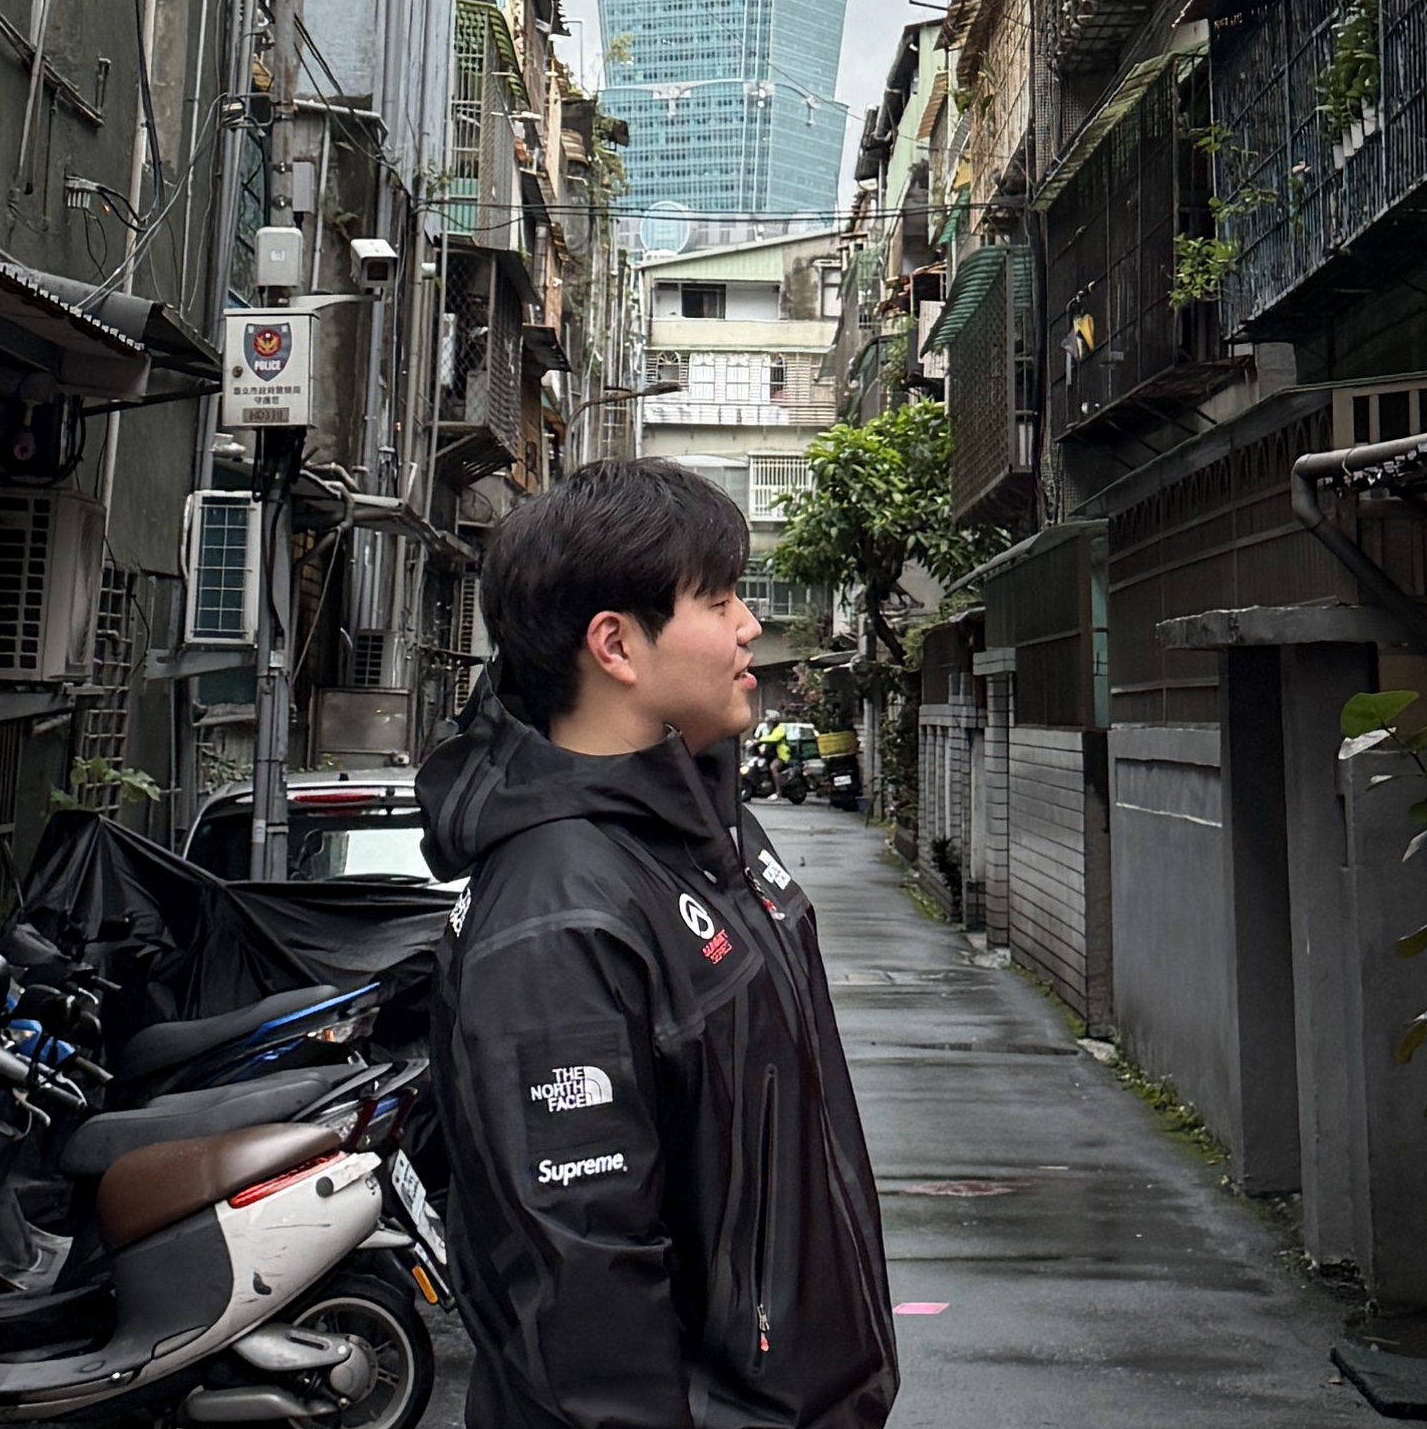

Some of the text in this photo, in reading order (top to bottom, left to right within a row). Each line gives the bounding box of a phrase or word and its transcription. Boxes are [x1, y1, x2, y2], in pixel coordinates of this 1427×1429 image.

[254, 360, 281, 371] POLICE
[552, 1067, 584, 1083] THE
[531, 1080, 584, 1101] NORTH
[548, 1093, 586, 1112] FACE
[538, 1153, 624, 1186] Supreme
